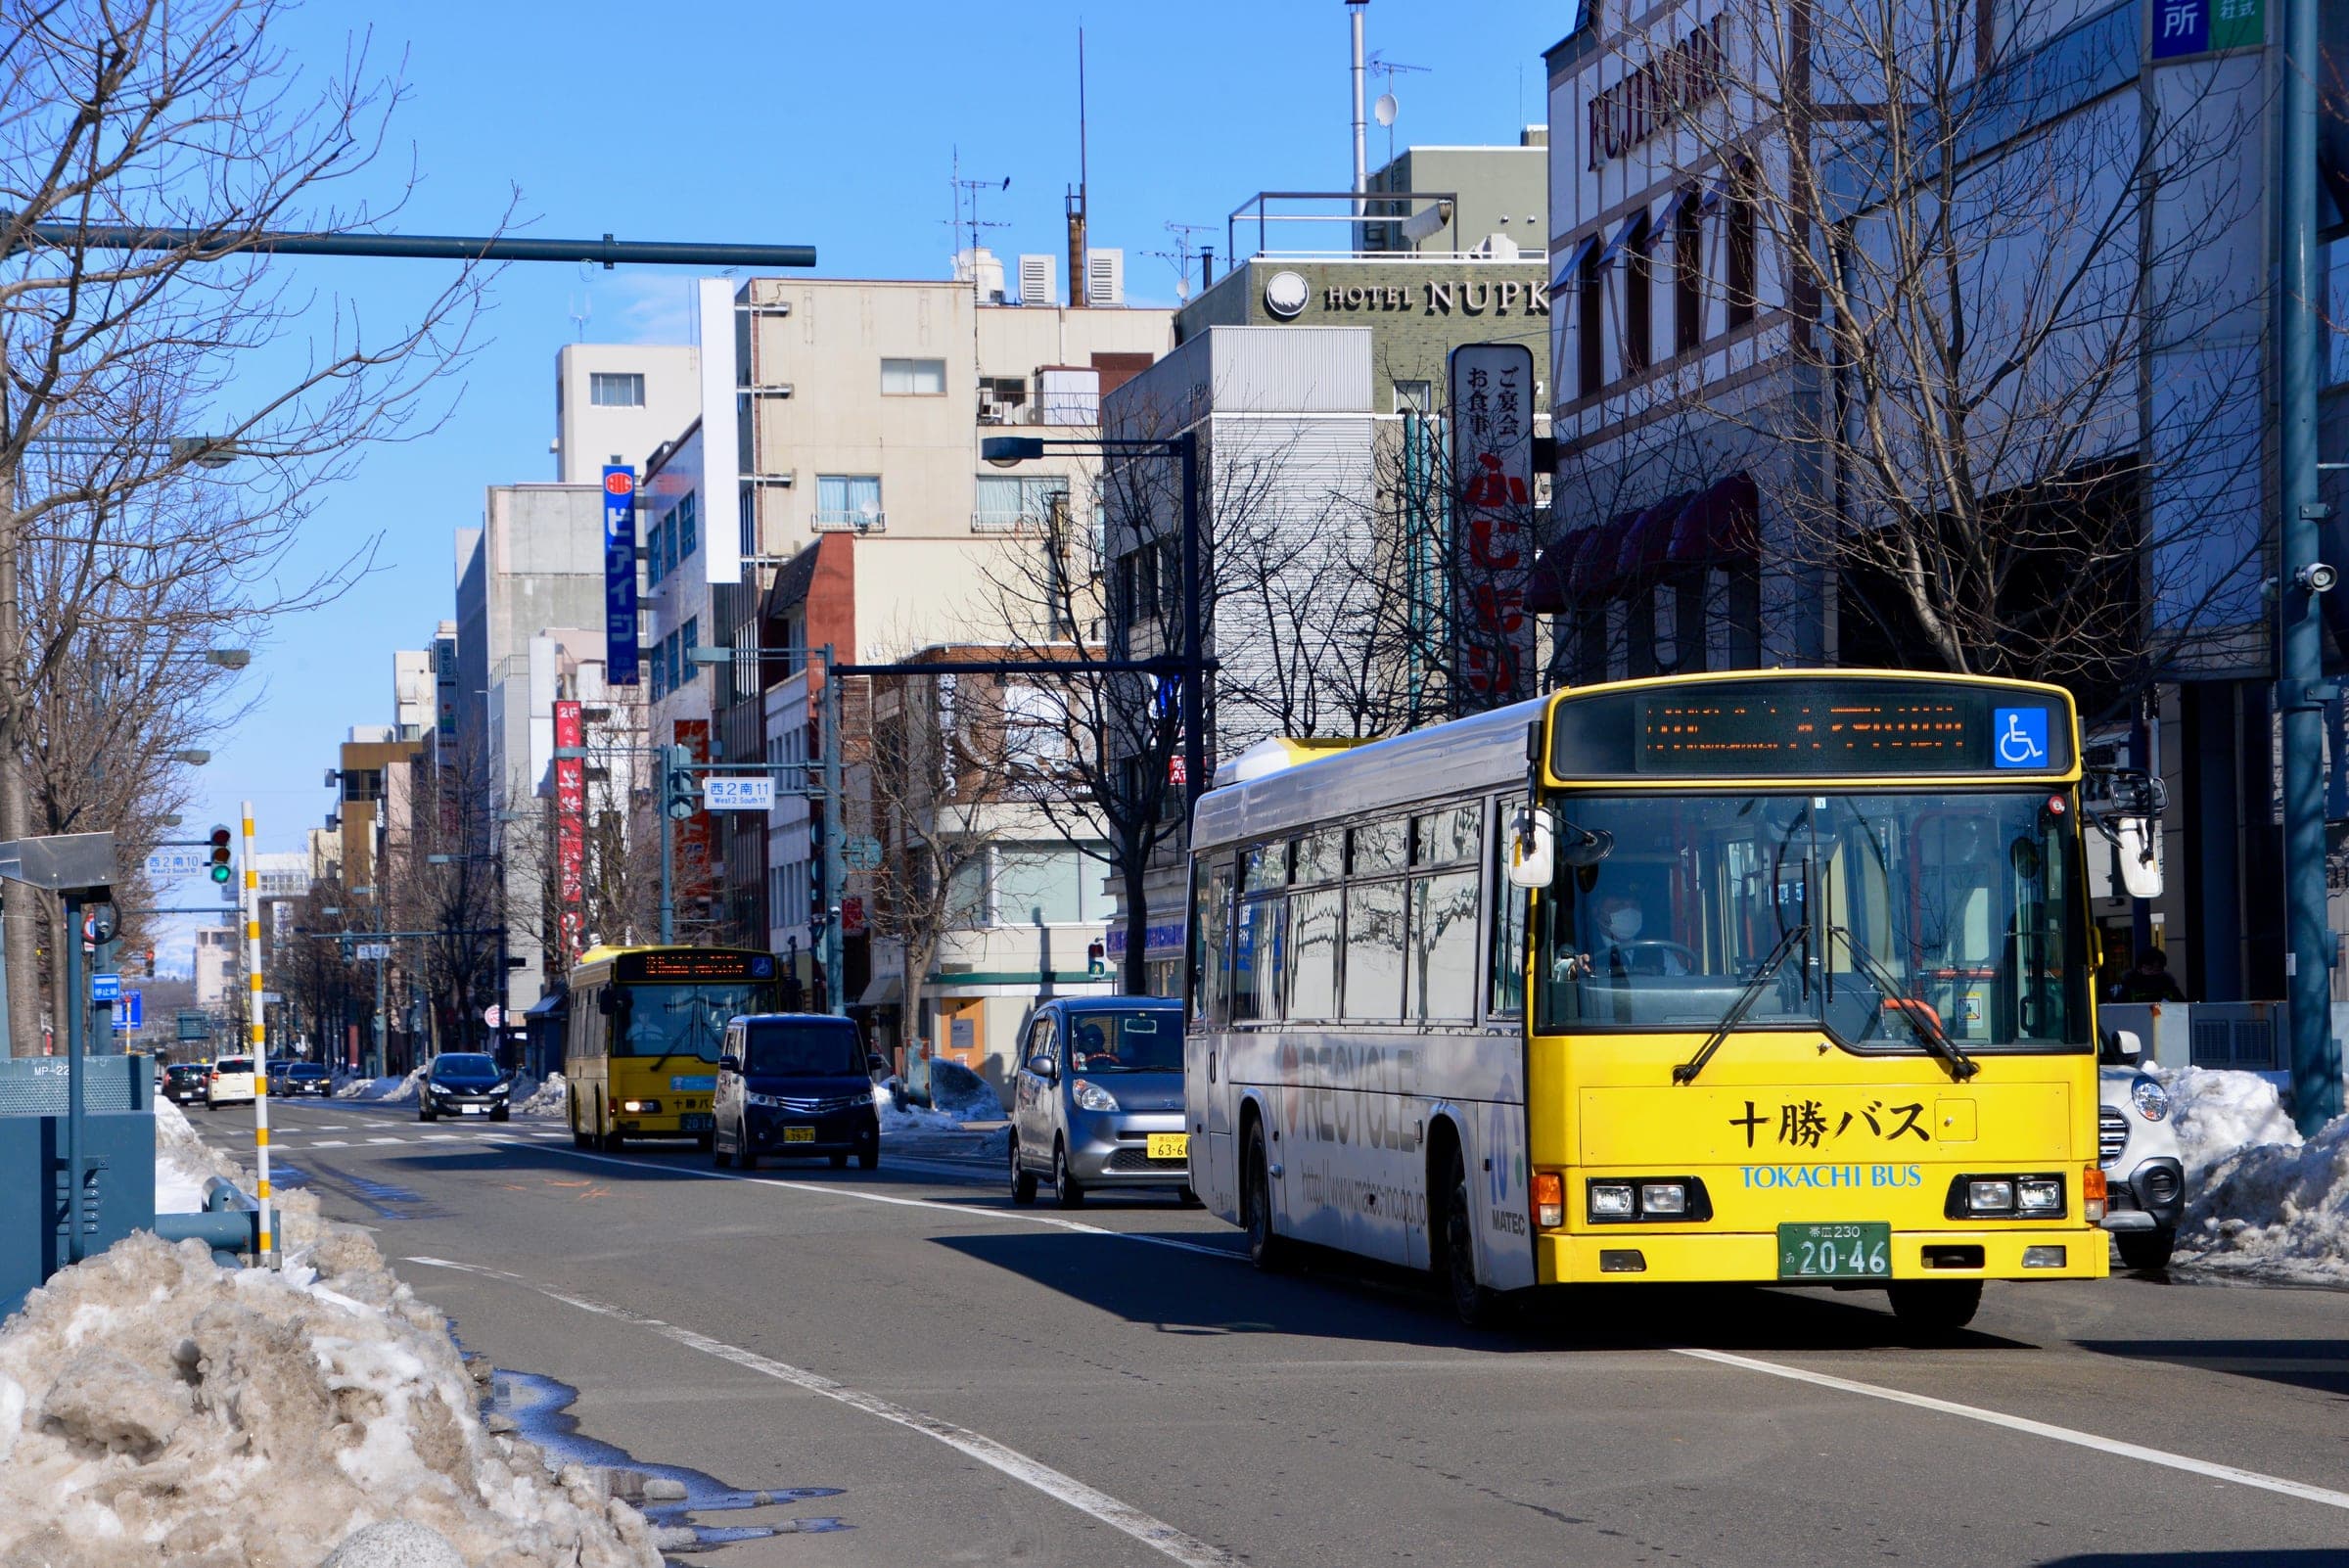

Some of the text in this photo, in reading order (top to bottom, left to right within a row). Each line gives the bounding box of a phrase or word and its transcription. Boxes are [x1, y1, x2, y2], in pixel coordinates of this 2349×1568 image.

[1588, 12, 1725, 172] FUJIMORI
[1327, 285, 1415, 305] HOTEL
[1466, 366, 1491, 436] お食事
[1498, 366, 1520, 437] ご宴会
[559, 707, 578, 718] 2F
[711, 782, 768, 796] 西2南11
[149, 854, 199, 867] 西2南10
[1303, 1045, 1415, 1153] RECYCLE
[1728, 1099, 1930, 1149] 十勝バス
[1739, 1165, 1921, 1188] TOKACHI BUS
[1493, 1209, 1525, 1235] MATEC
[1809, 1225, 1861, 1238] 帯広230
[1800, 1240, 1887, 1274] 20-46
